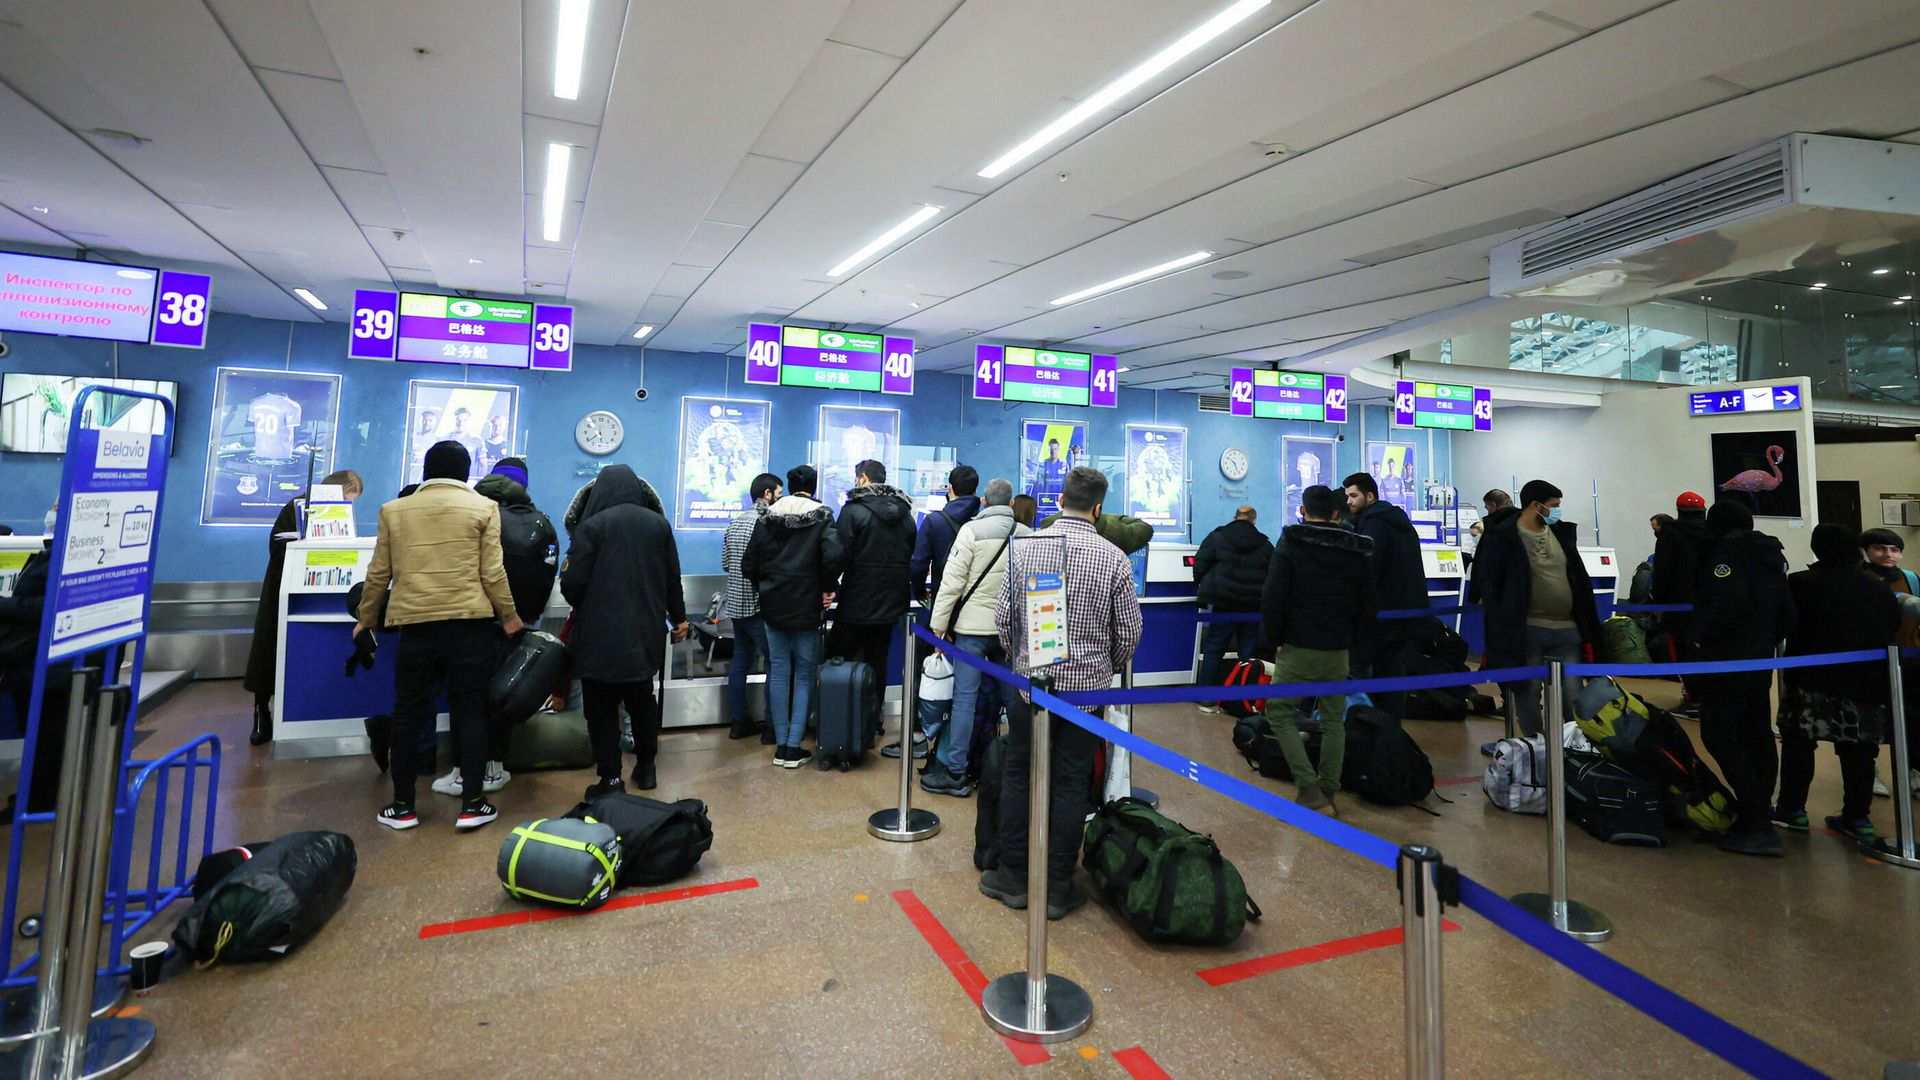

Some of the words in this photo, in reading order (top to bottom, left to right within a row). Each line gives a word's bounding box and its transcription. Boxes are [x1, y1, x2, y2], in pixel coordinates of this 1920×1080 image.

[5, 273, 105, 295] Инспектор
[111, 286, 133, 296] по
[0, 292, 149, 316] пловизионному
[159, 291, 206, 327] 38
[19, 310, 112, 326] контролю
[354, 308, 394, 340] 39
[448, 323, 486, 336] 巴格达
[535, 322, 571, 352] 39
[749, 340, 780, 367] 40
[885, 352, 913, 378] 40
[977, 360, 1001, 384] 41
[1093, 369, 1116, 392] 41
[1232, 381, 1252, 403] 42
[1326, 388, 1346, 410] 42
[1396, 393, 1413, 413] 43
[1719, 396, 1741, 408] A-F
[1475, 400, 1491, 420] 43
[255, 413, 278, 435] 20
[103, 440, 145, 457] Belavia
[76, 497, 111, 510] Economy
[104, 512, 110, 527] 1
[132, 521, 140, 530] 10
[141, 521, 148, 531] kg
[70, 536, 104, 549] Business
[97, 548, 105, 564] 2
